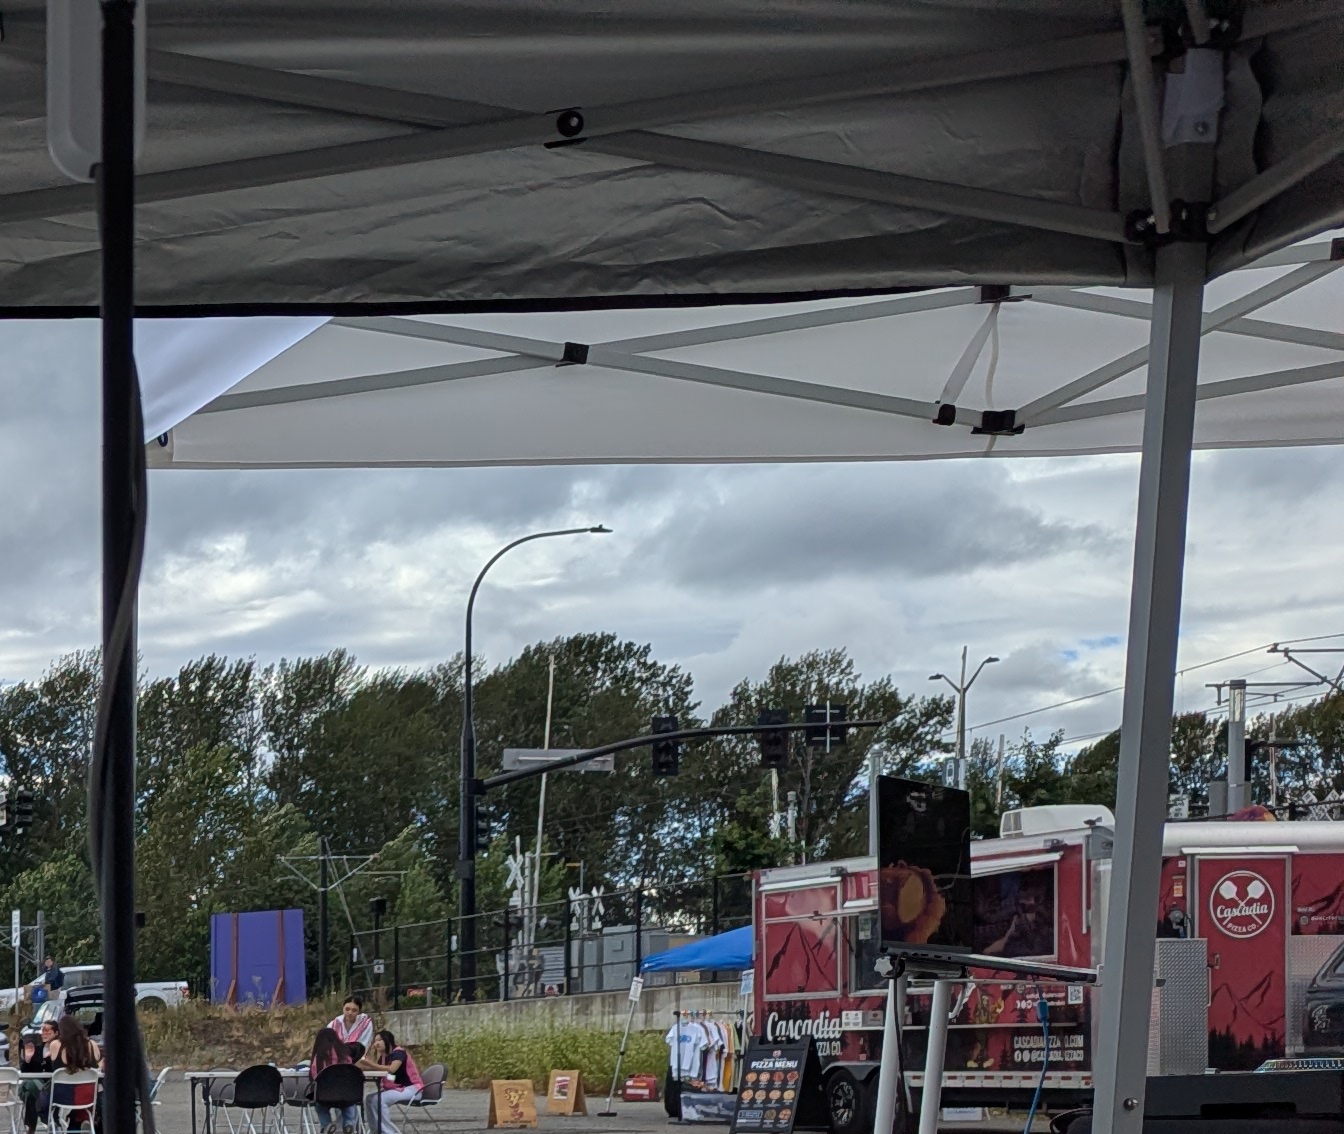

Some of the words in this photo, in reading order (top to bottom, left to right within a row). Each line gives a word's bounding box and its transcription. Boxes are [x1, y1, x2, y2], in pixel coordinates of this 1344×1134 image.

[1216, 902, 1269, 919] Cascadia
[1227, 922, 1247, 932] PIZZA
[767, 1010, 843, 1042] Cascadia
[750, 1060, 774, 1069] PIZZA
